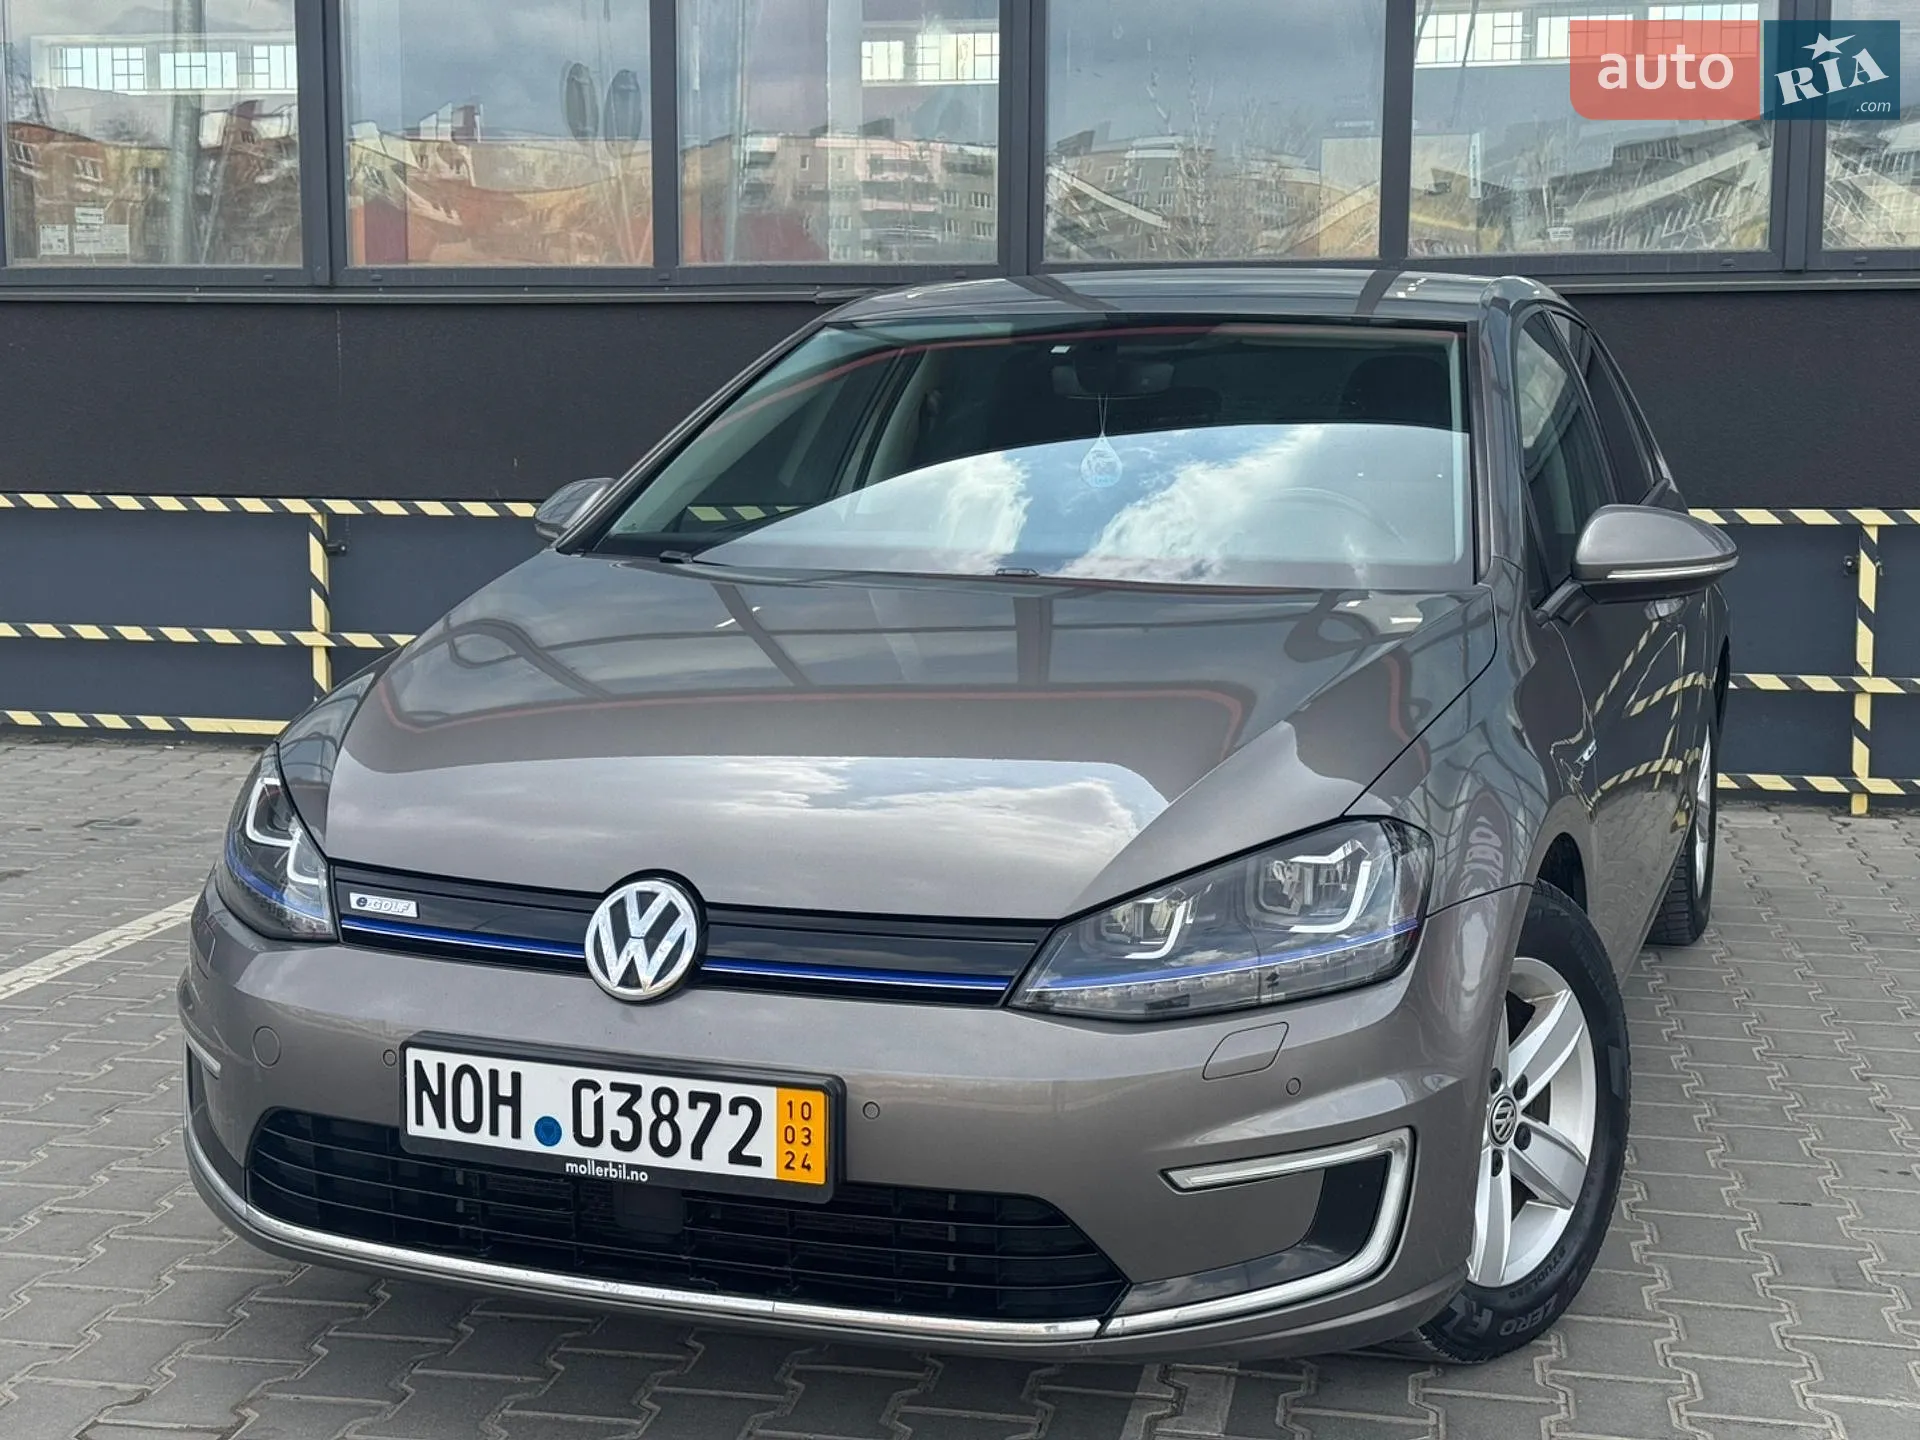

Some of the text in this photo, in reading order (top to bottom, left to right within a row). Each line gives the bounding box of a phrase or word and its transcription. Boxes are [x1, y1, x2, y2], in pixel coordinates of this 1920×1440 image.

[413, 1058, 763, 1168] NOH 03872
[787, 1100, 812, 1121] 10
[784, 1125, 812, 1147] 03
[565, 1159, 648, 1182] mollerbil.no
[784, 1150, 812, 1172] 24
